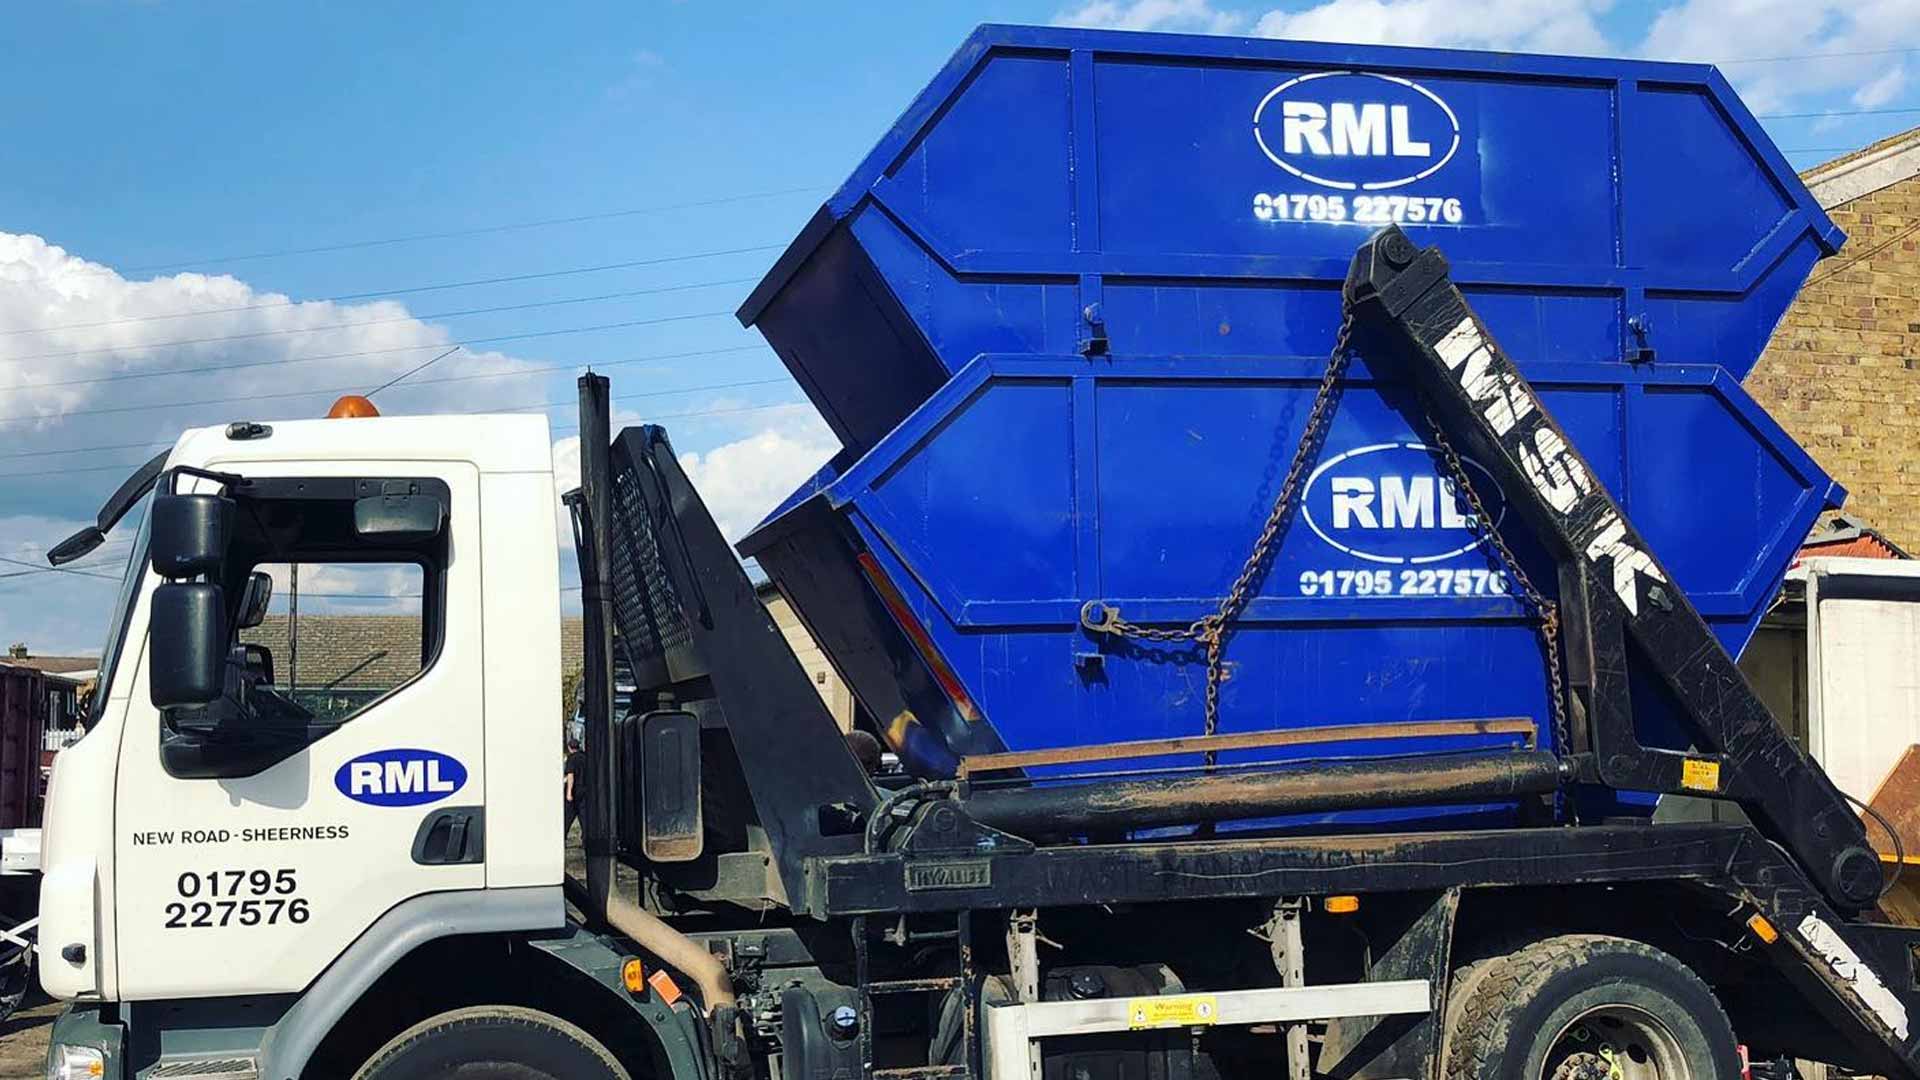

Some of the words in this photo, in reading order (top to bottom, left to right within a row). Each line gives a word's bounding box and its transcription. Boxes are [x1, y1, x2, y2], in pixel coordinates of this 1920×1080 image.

[1282, 100, 1431, 157] RML
[1253, 193, 1346, 220] 01795
[1352, 196, 1463, 223] 227576
[1331, 476, 1480, 529] RML
[1300, 570, 1392, 596] 01795
[1399, 569, 1507, 595] 227576
[349, 759, 455, 796] RML
[133, 832, 175, 846] NEW
[181, 830, 231, 844] ROAD
[241, 825, 350, 842] SHEERNESS
[177, 869, 297, 898] 01795
[164, 898, 310, 929] 227576
